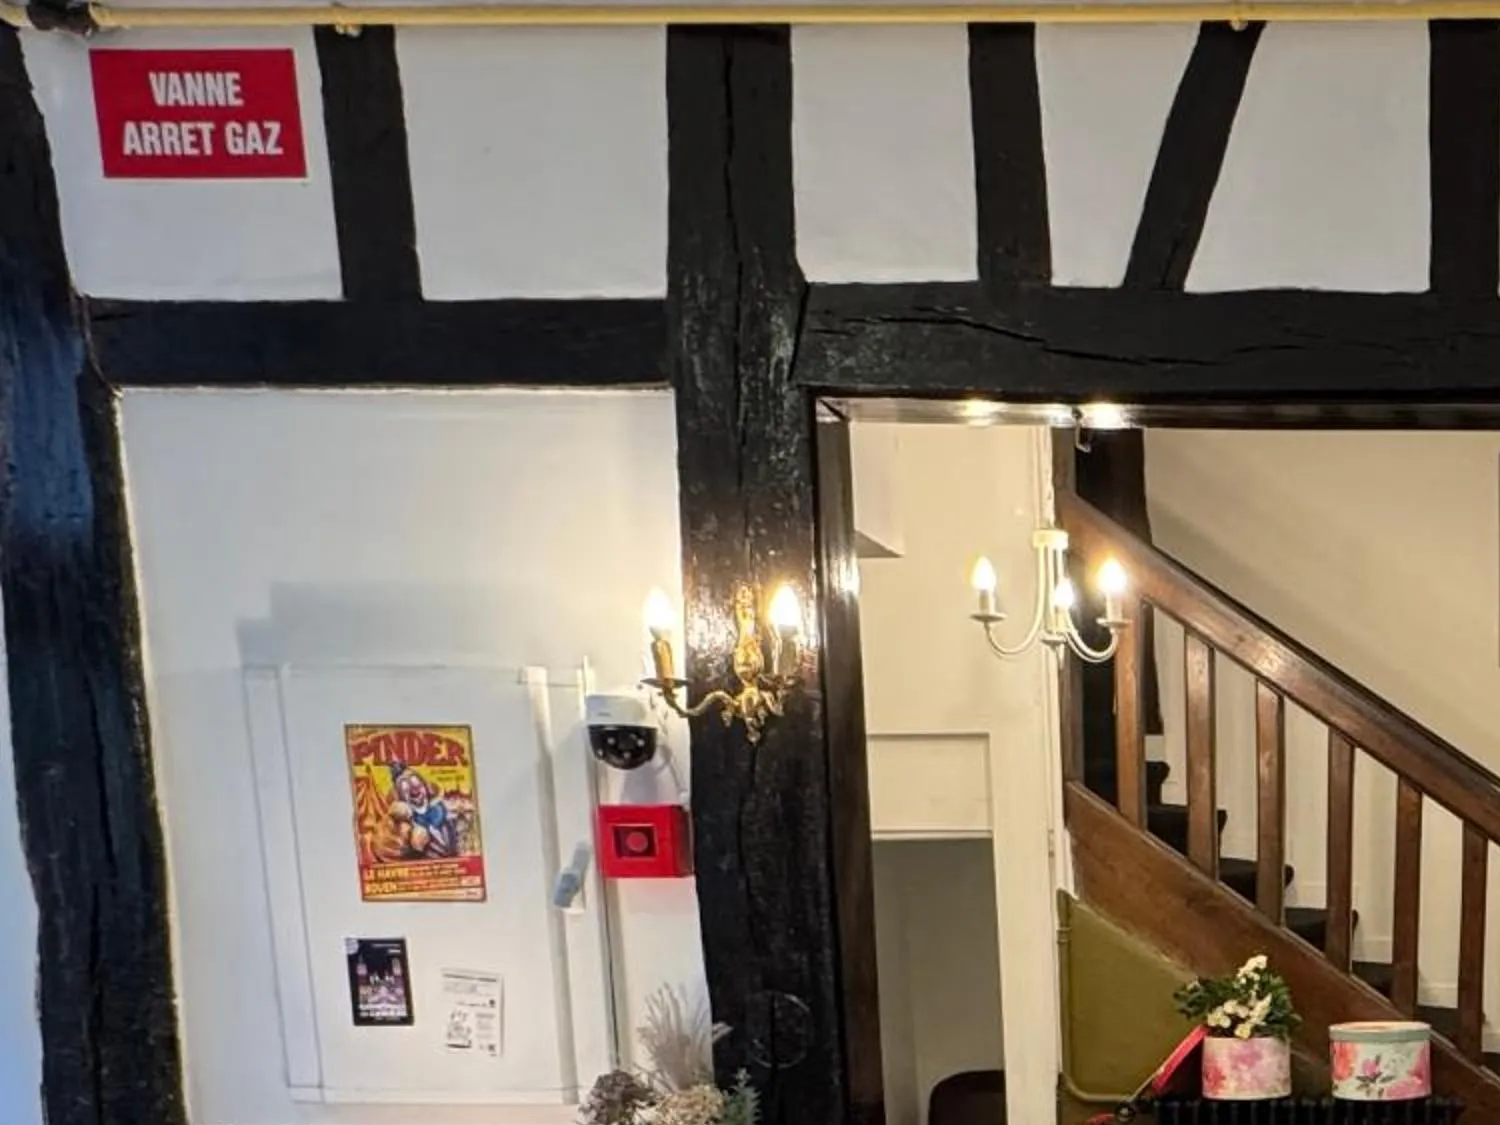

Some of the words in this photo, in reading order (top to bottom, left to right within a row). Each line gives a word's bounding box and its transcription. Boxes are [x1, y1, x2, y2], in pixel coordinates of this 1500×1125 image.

[148, 71, 244, 107] VANNE
[122, 120, 215, 156] ARRET
[224, 120, 284, 156] GAZ
